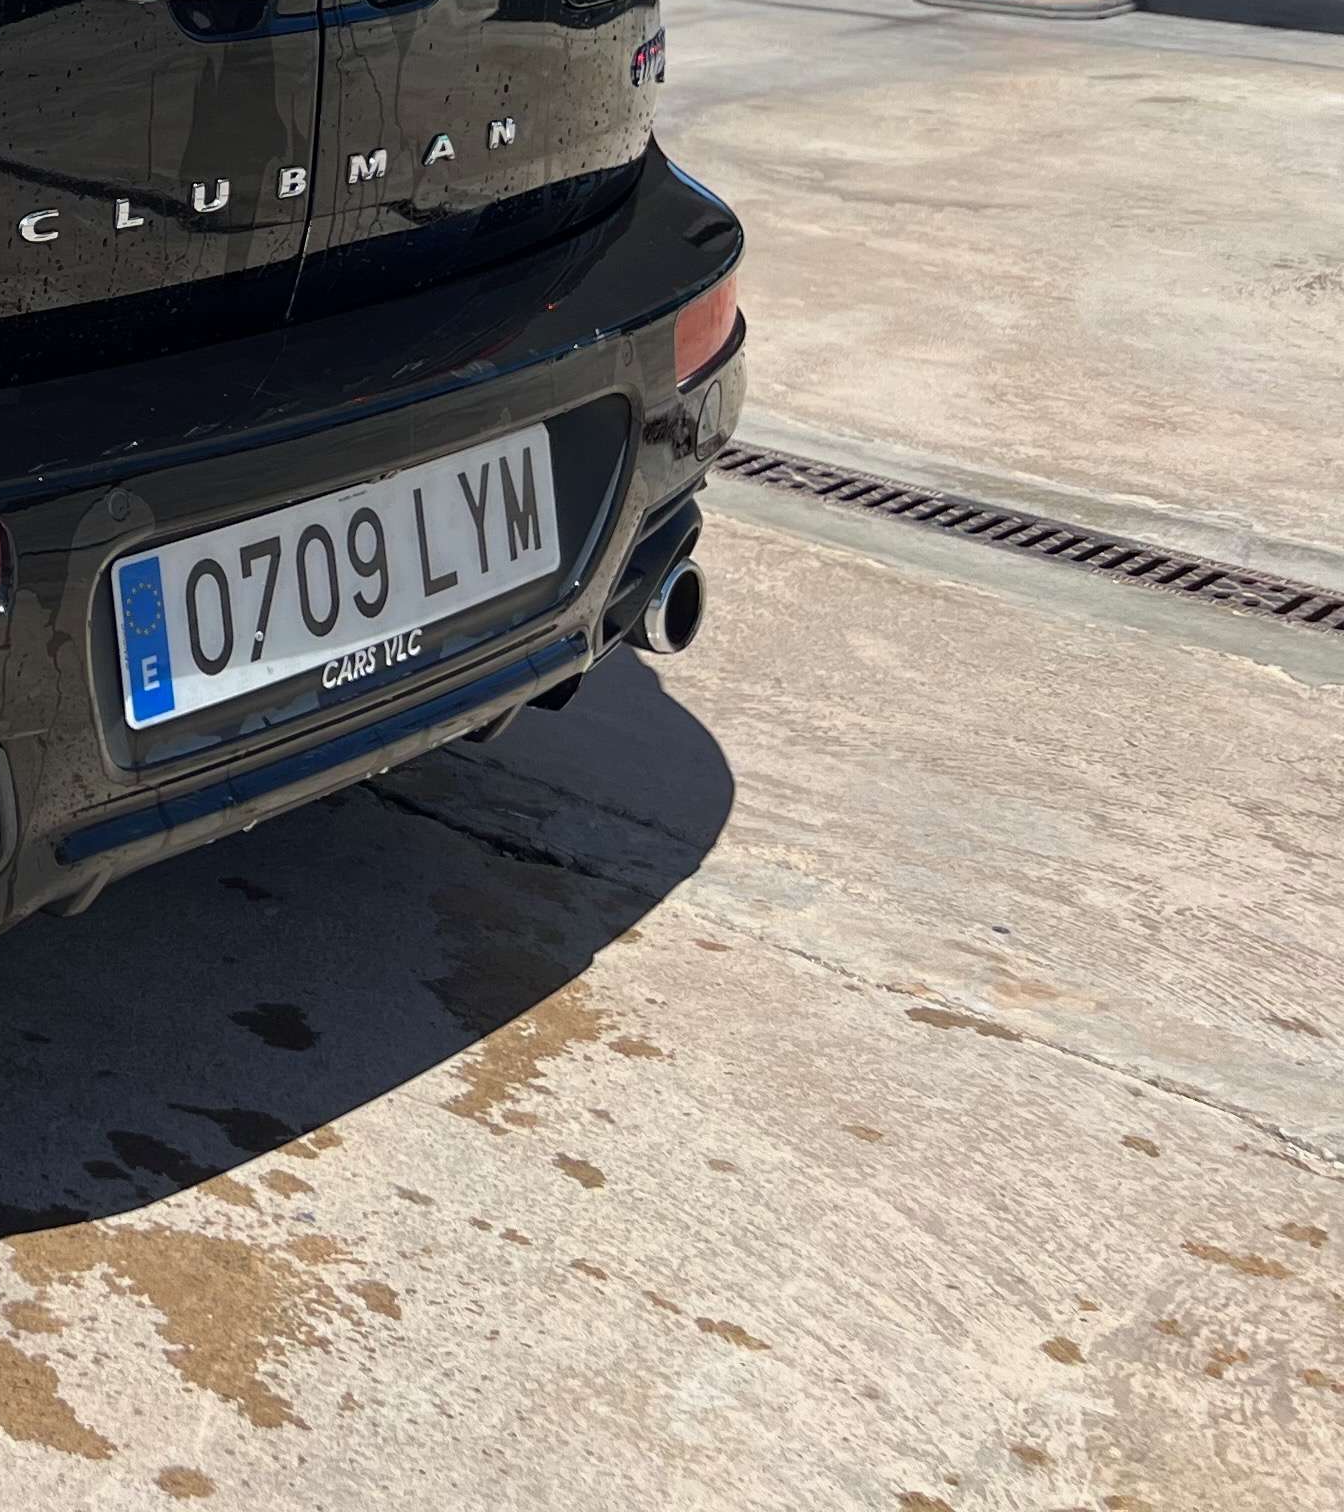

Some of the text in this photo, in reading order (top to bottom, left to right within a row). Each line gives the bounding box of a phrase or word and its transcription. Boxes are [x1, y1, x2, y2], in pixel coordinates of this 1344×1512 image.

[18, 118, 517, 245] CLUBMAN
[185, 446, 543, 677] 0709 LYM
[140, 655, 160, 693] E
[322, 628, 424, 690] CARS VLC
